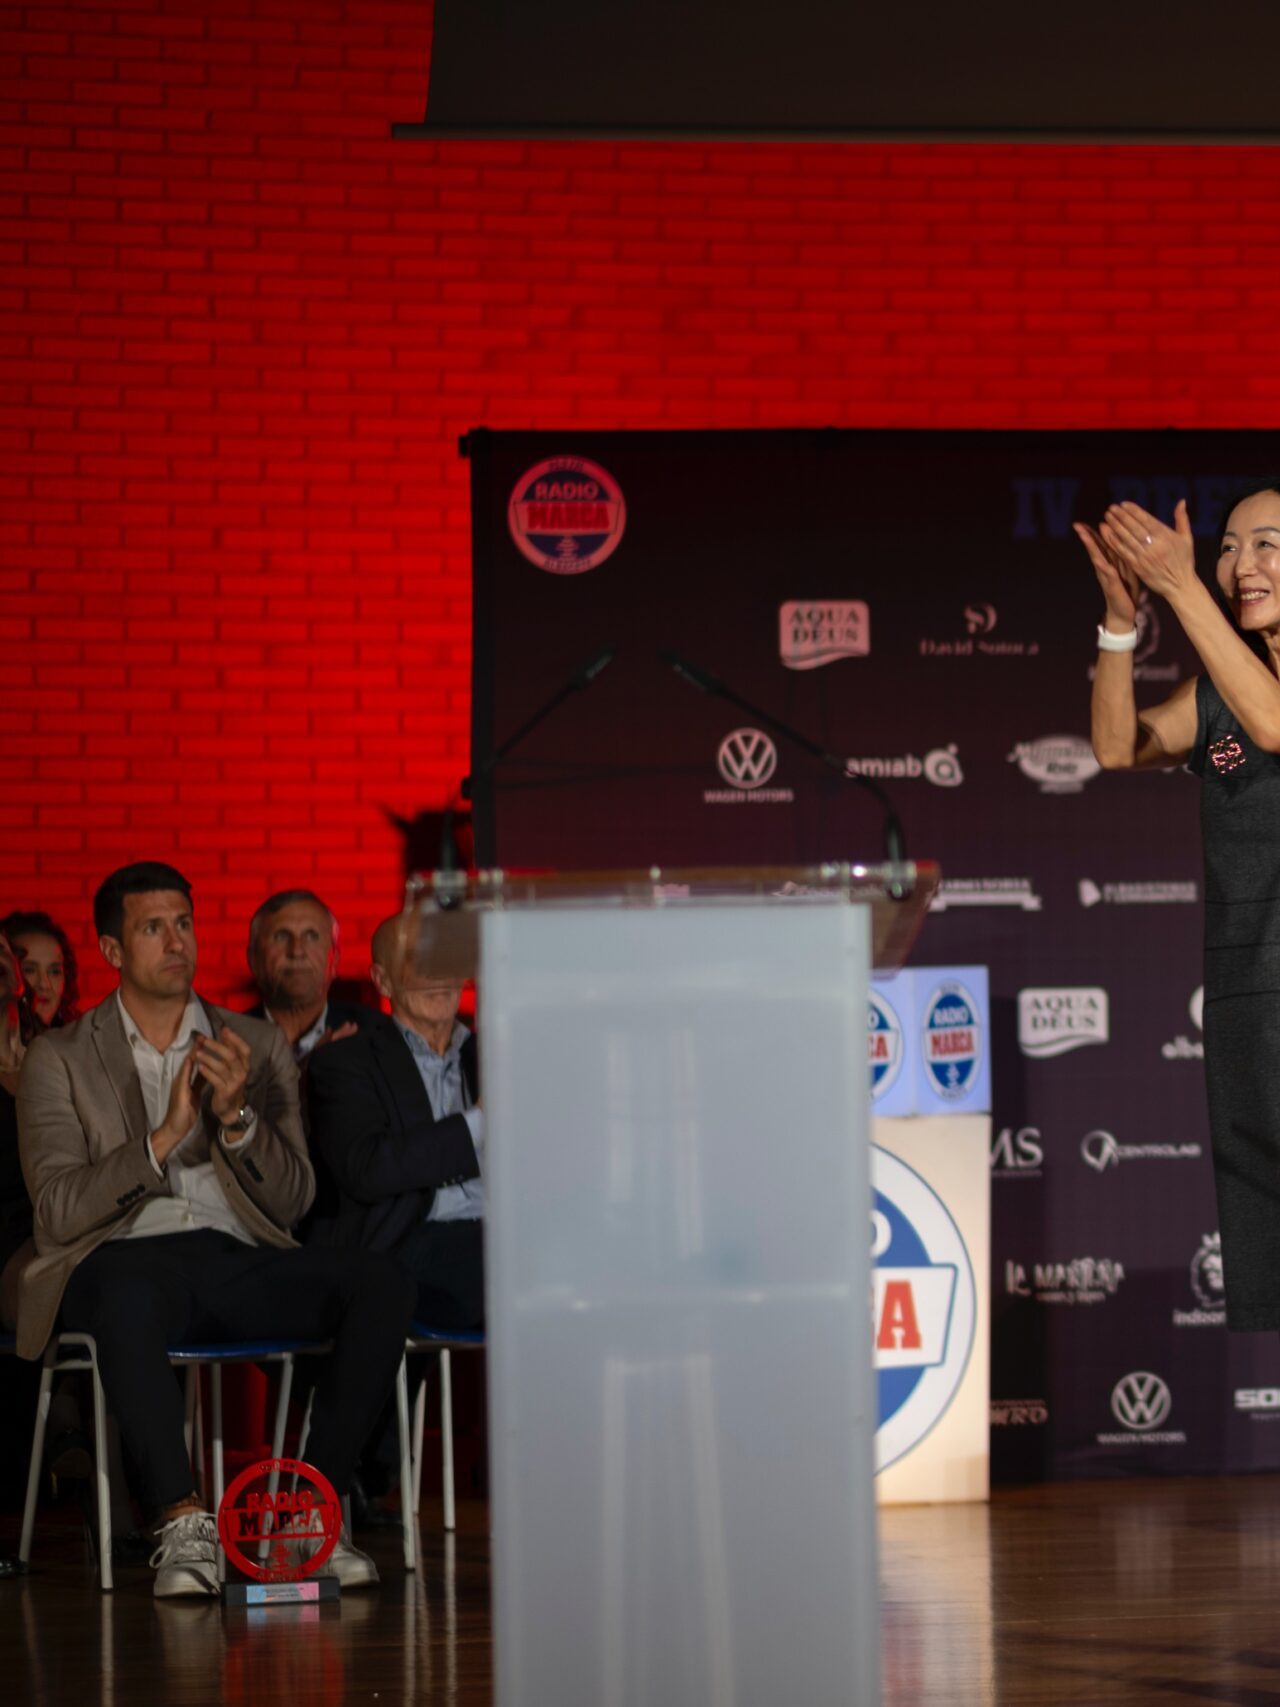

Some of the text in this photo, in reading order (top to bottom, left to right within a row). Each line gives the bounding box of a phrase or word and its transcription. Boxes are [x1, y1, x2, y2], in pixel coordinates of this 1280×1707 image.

[534, 481, 601, 500] RADIO
[528, 502, 610, 529] MARCA
[1010, 477, 1080, 538] IV
[789, 608, 860, 626] AQUA
[793, 627, 858, 644] DEUS
[747, 788, 795, 803] MOTORS
[934, 1005, 970, 1027] RADIO
[1031, 997, 1099, 1015] AQUA
[1031, 1015, 1097, 1031] DEUS
[930, 1030, 975, 1058] MARCA
[991, 1126, 1043, 1169] MS
[244, 1489, 315, 1509] RADIO
[237, 1507, 325, 1537] MARCA
